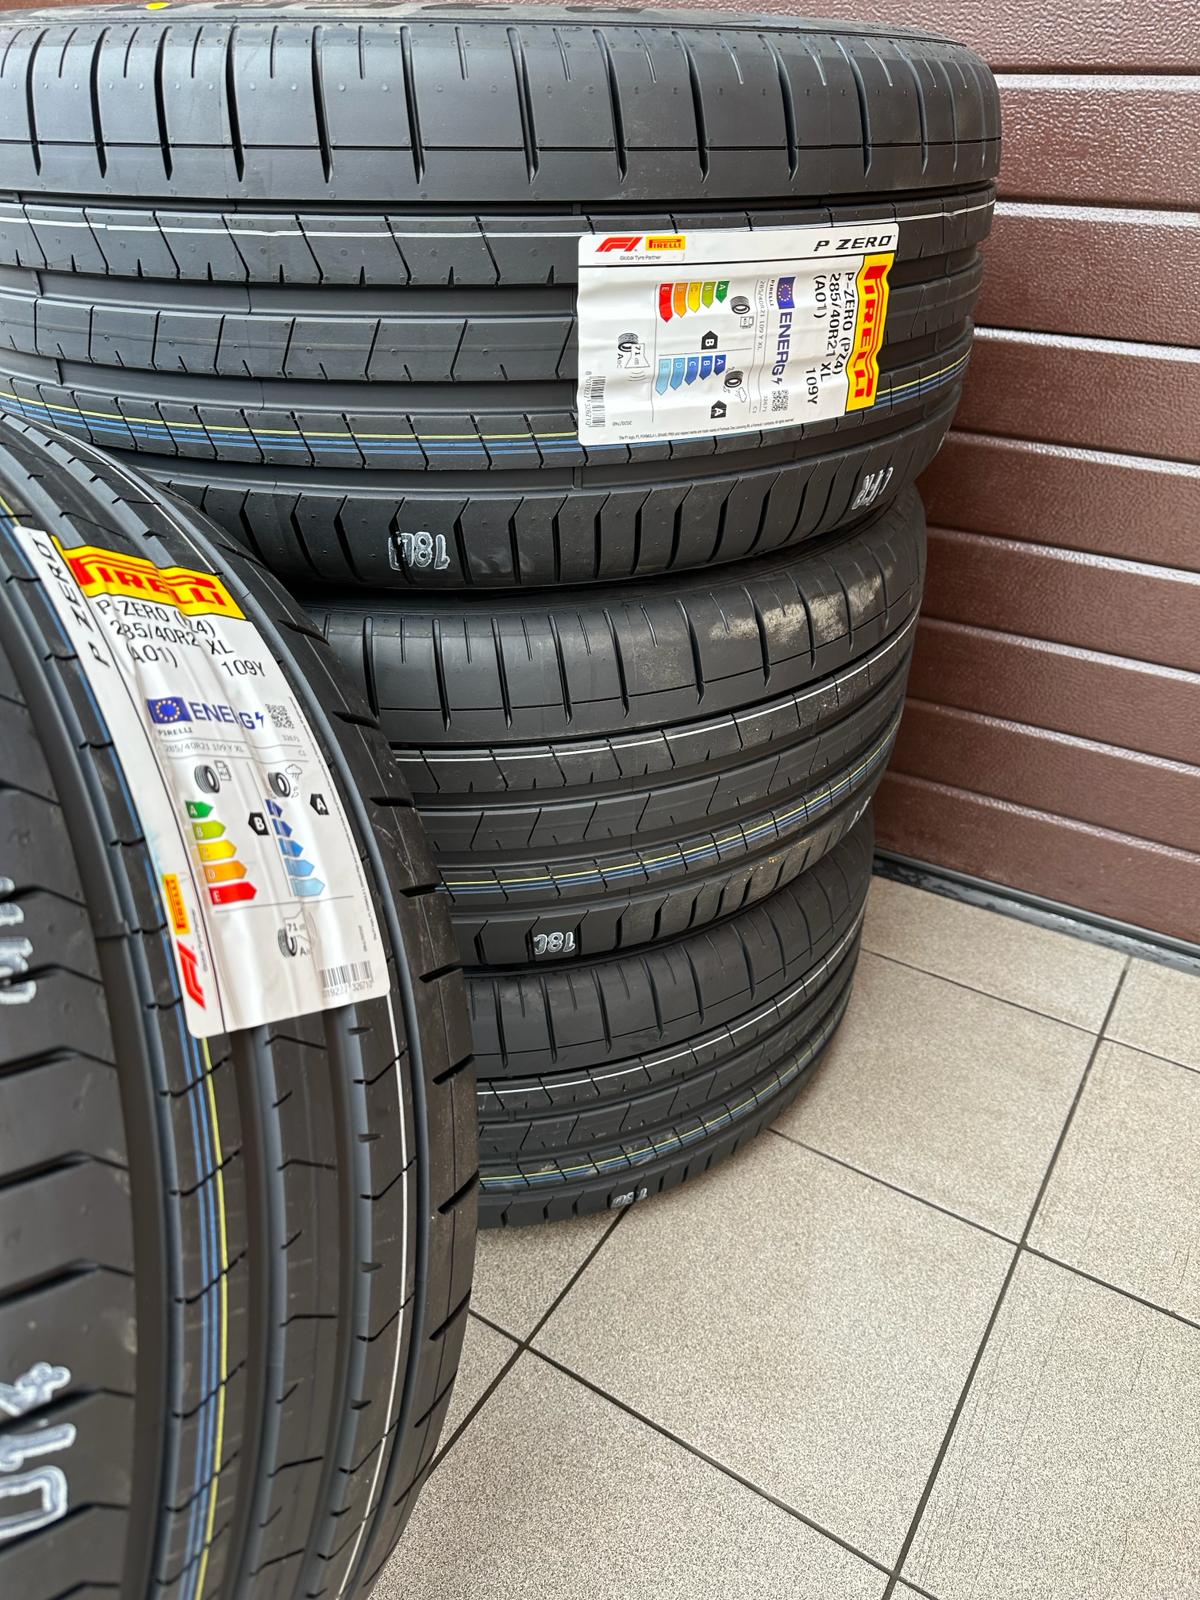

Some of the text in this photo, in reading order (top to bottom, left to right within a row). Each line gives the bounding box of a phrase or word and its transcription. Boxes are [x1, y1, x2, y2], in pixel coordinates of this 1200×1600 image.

[648, 238, 682, 249] PIRELLI
[813, 235, 893, 252] P ZERO
[645, 254, 662, 262] Partner
[768, 279, 776, 307] PIRELLI
[820, 273, 841, 382] 285/40R21 XL
[831, 271, 856, 375] P-ZERO (PZ4)
[853, 264, 888, 398] PIRELLI
[634, 345, 641, 356] 71
[705, 339, 714, 347] B
[771, 311, 793, 377] ENERG
[805, 367, 819, 405] 109Y
[714, 407, 724, 416] A
[68, 554, 228, 607] PIRELLI
[32, 536, 111, 668] P ZERO
[205, 639, 234, 655] XL
[221, 659, 266, 677] 109Y
[157, 727, 193, 737] PIRELLI
[189, 804, 198, 815] A
[316, 798, 327, 811] A
[253, 817, 265, 830] B
